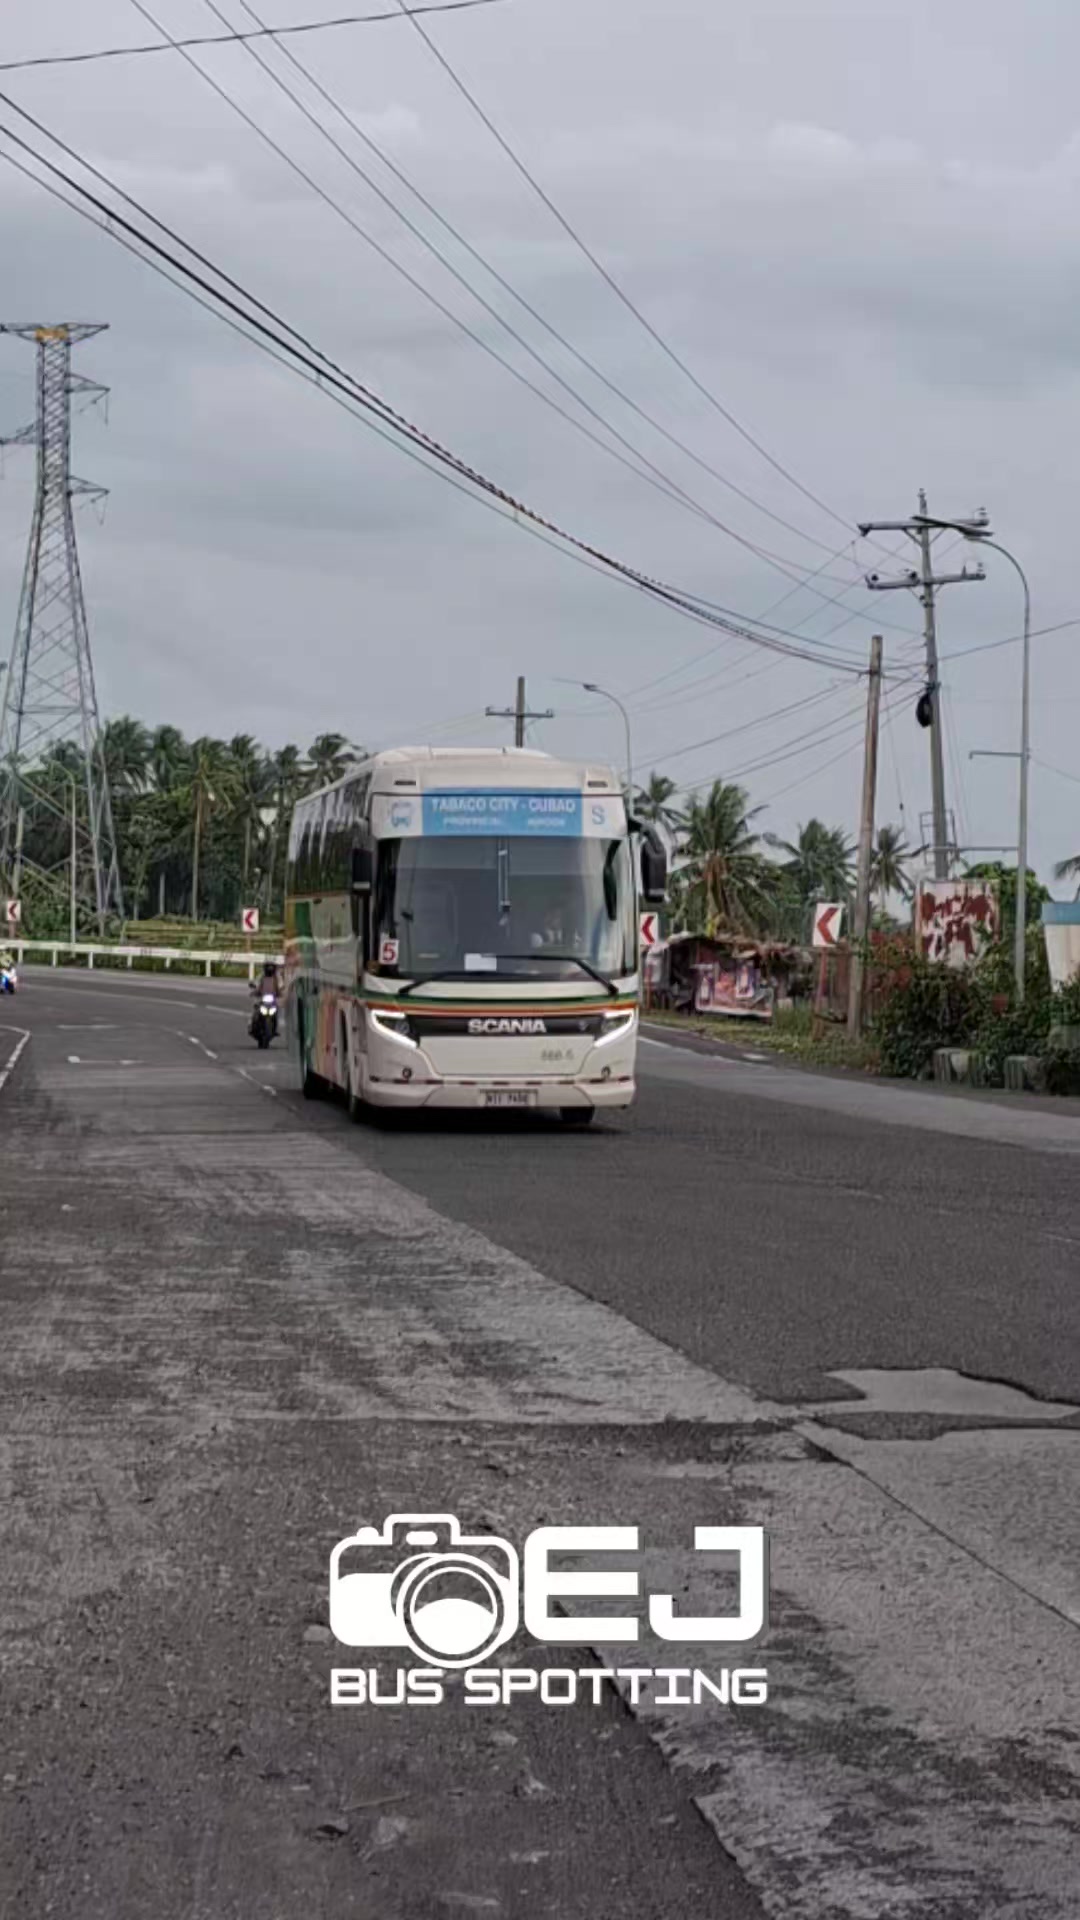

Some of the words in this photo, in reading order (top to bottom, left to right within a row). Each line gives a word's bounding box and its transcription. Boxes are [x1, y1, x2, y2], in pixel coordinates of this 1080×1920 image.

[431, 798, 486, 811] TABACO
[489, 798, 519, 811] CITY
[529, 799, 576, 813] CUBAO
[383, 942, 396, 961] 5
[468, 1018, 547, 1033] SCANIA
